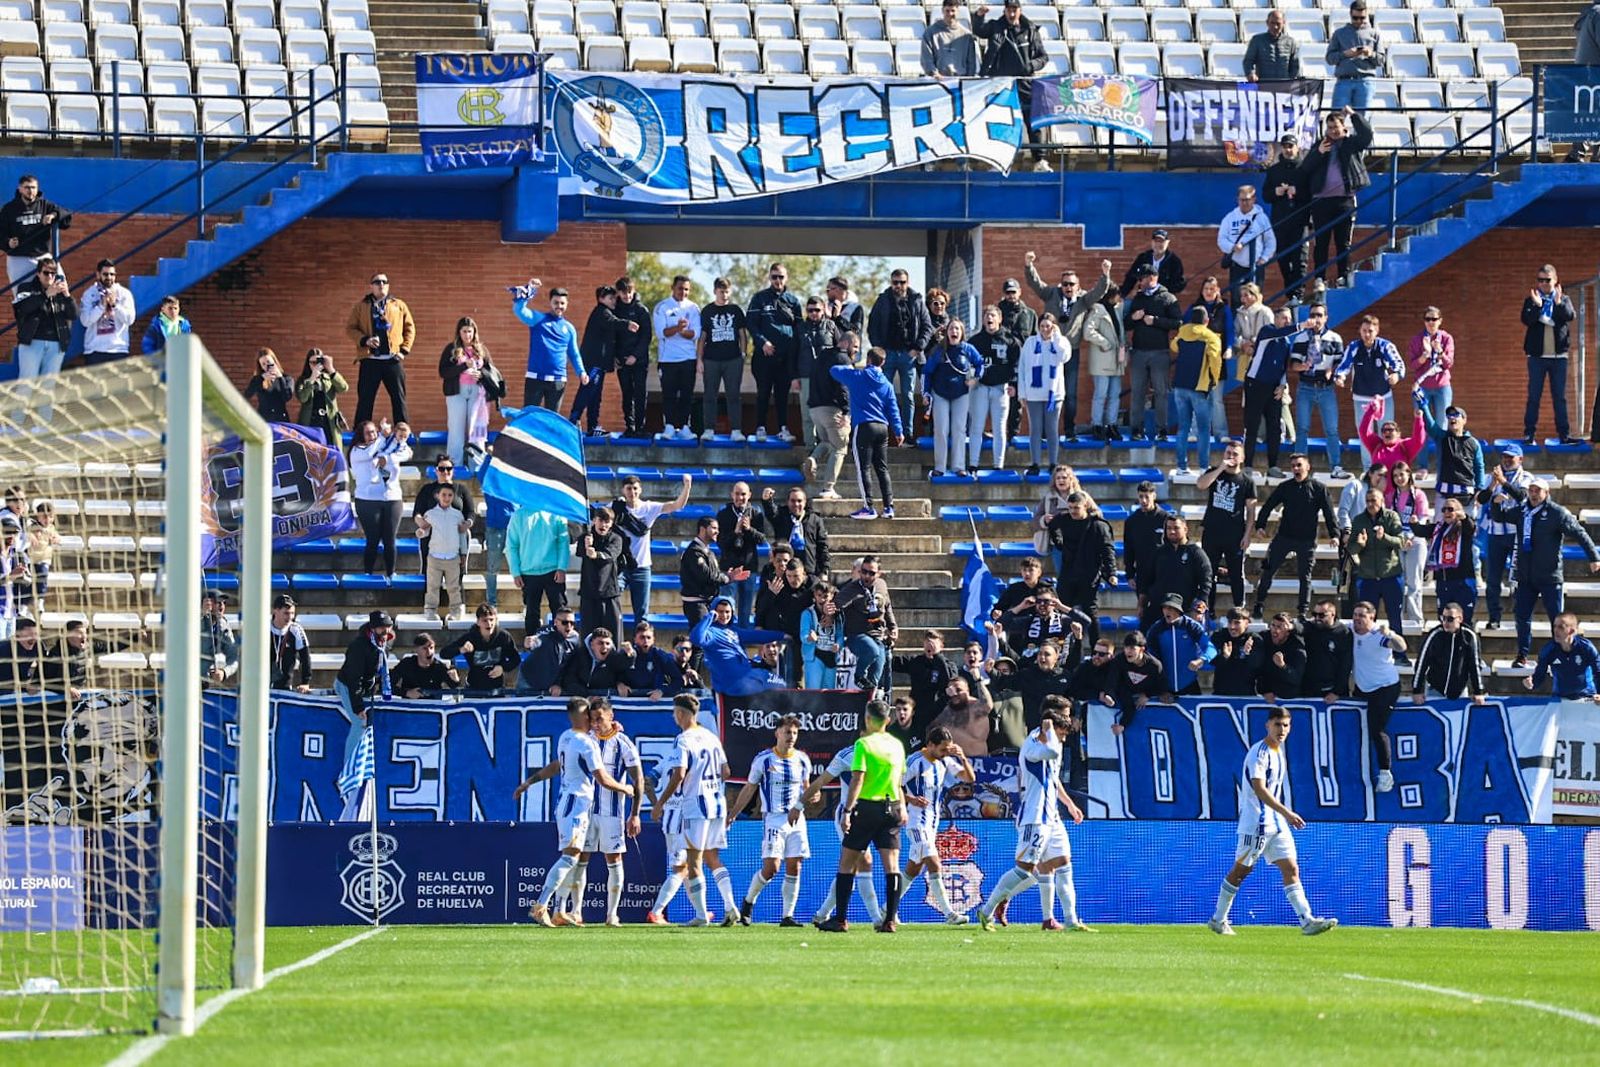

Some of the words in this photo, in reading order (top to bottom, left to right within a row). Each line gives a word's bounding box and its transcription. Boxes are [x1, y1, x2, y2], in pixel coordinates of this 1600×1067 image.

[1053, 104, 1145, 128] PANSARCÓ
[681, 79, 1022, 200] RECRE
[278, 510, 331, 536] ONUBA
[701, 747, 721, 780] 20
[1118, 703, 1533, 823] ONUBA
[0, 878, 19, 890] OL
[21, 874, 74, 890] ESPAÑOL
[418, 872, 449, 881] REAL
[452, 872, 485, 881] CLUB
[518, 867, 545, 877] 1889
[418, 885, 494, 895] RECREATIVO
[418, 899, 434, 908] DE
[437, 899, 484, 908] HUELVA
